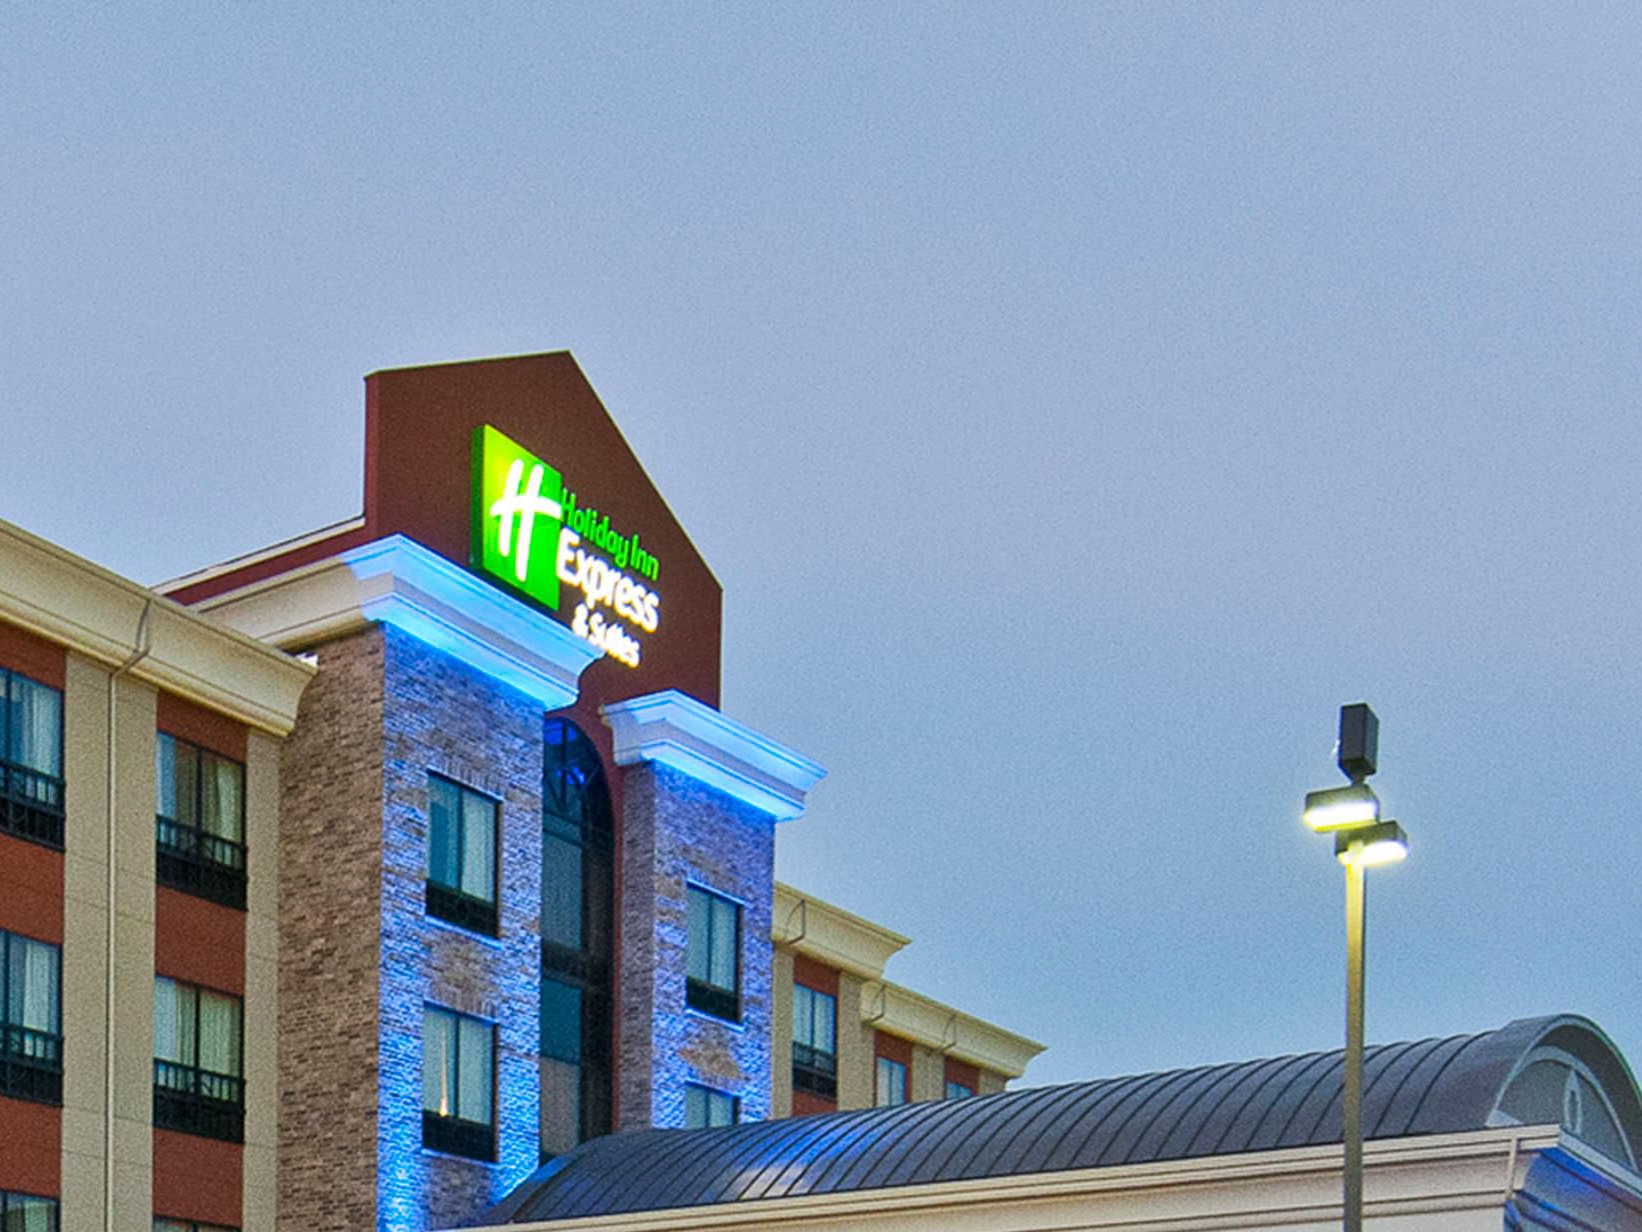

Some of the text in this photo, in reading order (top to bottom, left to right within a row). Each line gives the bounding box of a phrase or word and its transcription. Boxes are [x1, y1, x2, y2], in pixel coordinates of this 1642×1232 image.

[556, 526, 660, 633] Express
[561, 487, 660, 582] Holiday Inn
